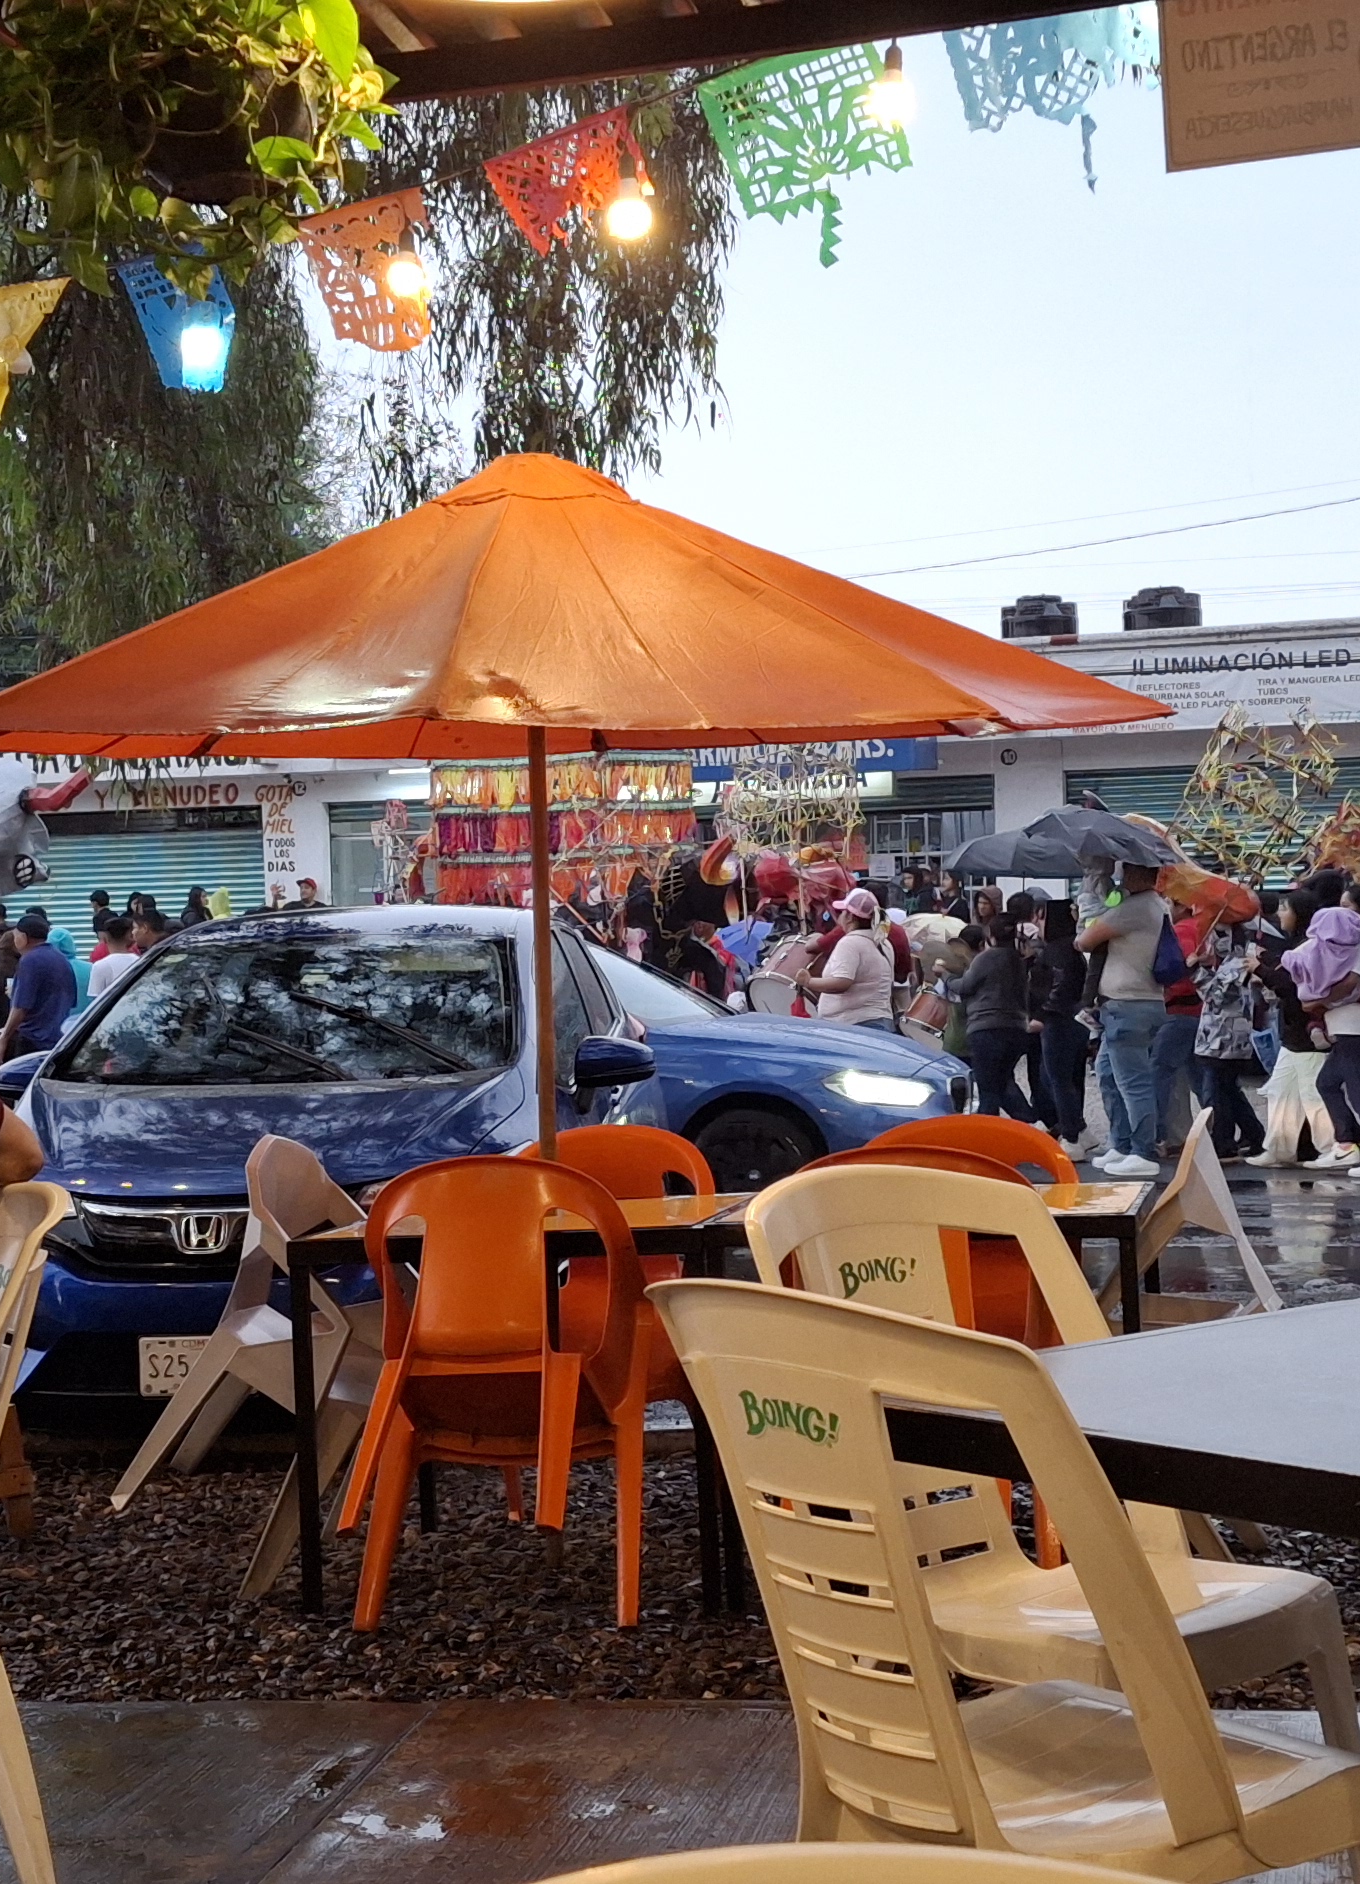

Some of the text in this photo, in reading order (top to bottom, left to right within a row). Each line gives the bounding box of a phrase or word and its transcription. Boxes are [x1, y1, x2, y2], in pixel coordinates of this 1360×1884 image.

[1133, 648, 1351, 676] ILUMINACIÓN LED
[1136, 682, 1200, 692] REFLECTORES
[1257, 678, 1278, 686] TIRA
[1288, 676, 1340, 685] MANGUERA
[1195, 690, 1225, 698] SOLAR
[1257, 688, 1288, 696] TUBOS
[1186, 701, 1198, 709] LED
[1248, 697, 1311, 706] SOBREPONER
[1328, 711, 1353, 721] 777
[1073, 724, 1117, 734] MAYOREO
[1128, 722, 1174, 731] MENUDEO
[255, 784, 294, 803] GOTA
[268, 801, 288, 818] DE
[263, 819, 295, 835] MIEL
[266, 838, 296, 848] TODOS
[274, 849, 290, 858] LOS
[267, 861, 296, 873] DIAS
[839, 1256, 917, 1299] BOING!
[182, 1339, 206, 1349] CDM
[148, 1353, 189, 1379] S25
[738, 1390, 840, 1448] BOING!
